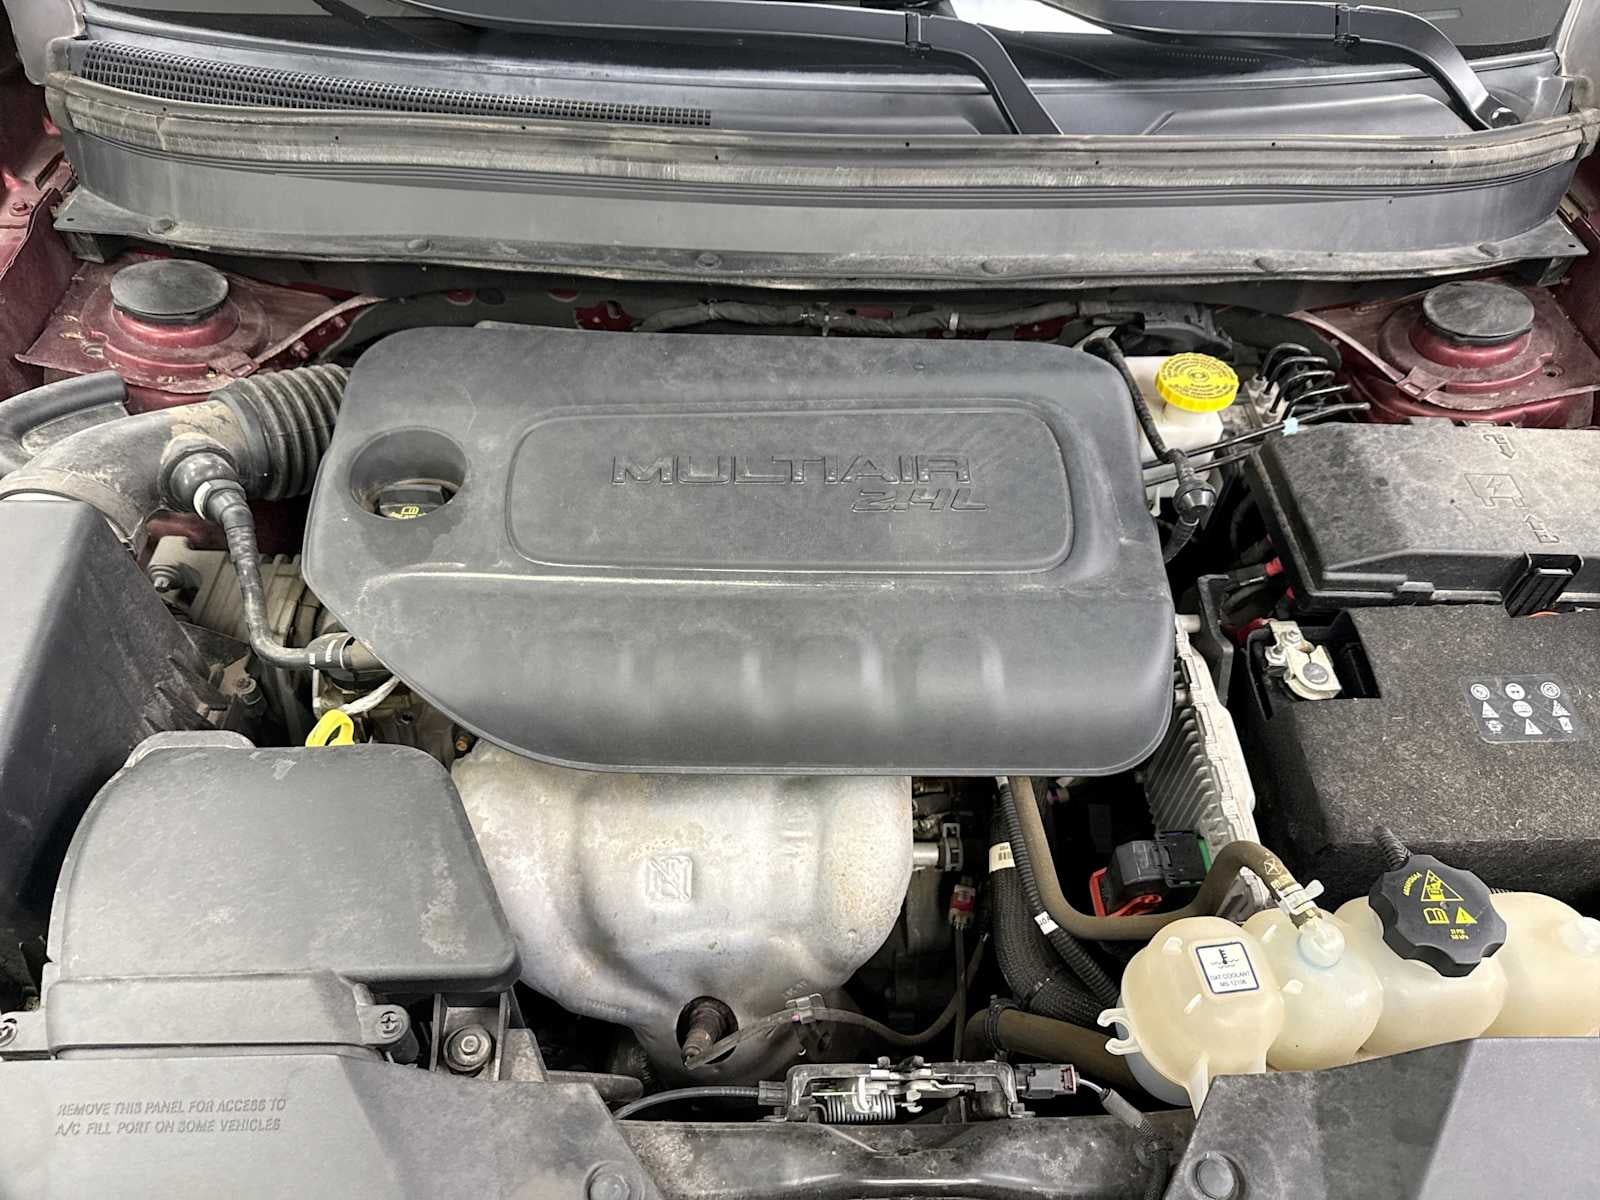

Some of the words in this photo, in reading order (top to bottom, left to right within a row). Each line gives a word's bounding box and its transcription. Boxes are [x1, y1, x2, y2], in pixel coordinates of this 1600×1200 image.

[610, 454, 972, 486] MULTIAIR
[850, 487, 991, 513] 2.4L
[57, 1102, 110, 1117] REMOVE
[114, 1101, 142, 1115] THIS
[144, 1100, 185, 1115] PANEL
[188, 1099, 214, 1114] FOR
[216, 1099, 266, 1113] ACCESS
[269, 1098, 287, 1112] TO
[55, 1121, 80, 1136] A/C
[86, 1121, 112, 1135] FILL
[116, 1120, 151, 1134] PORT
[154, 1120, 175, 1133] ON
[178, 1119, 215, 1134] SOME
[219, 1118, 282, 1133] VEHICLES
